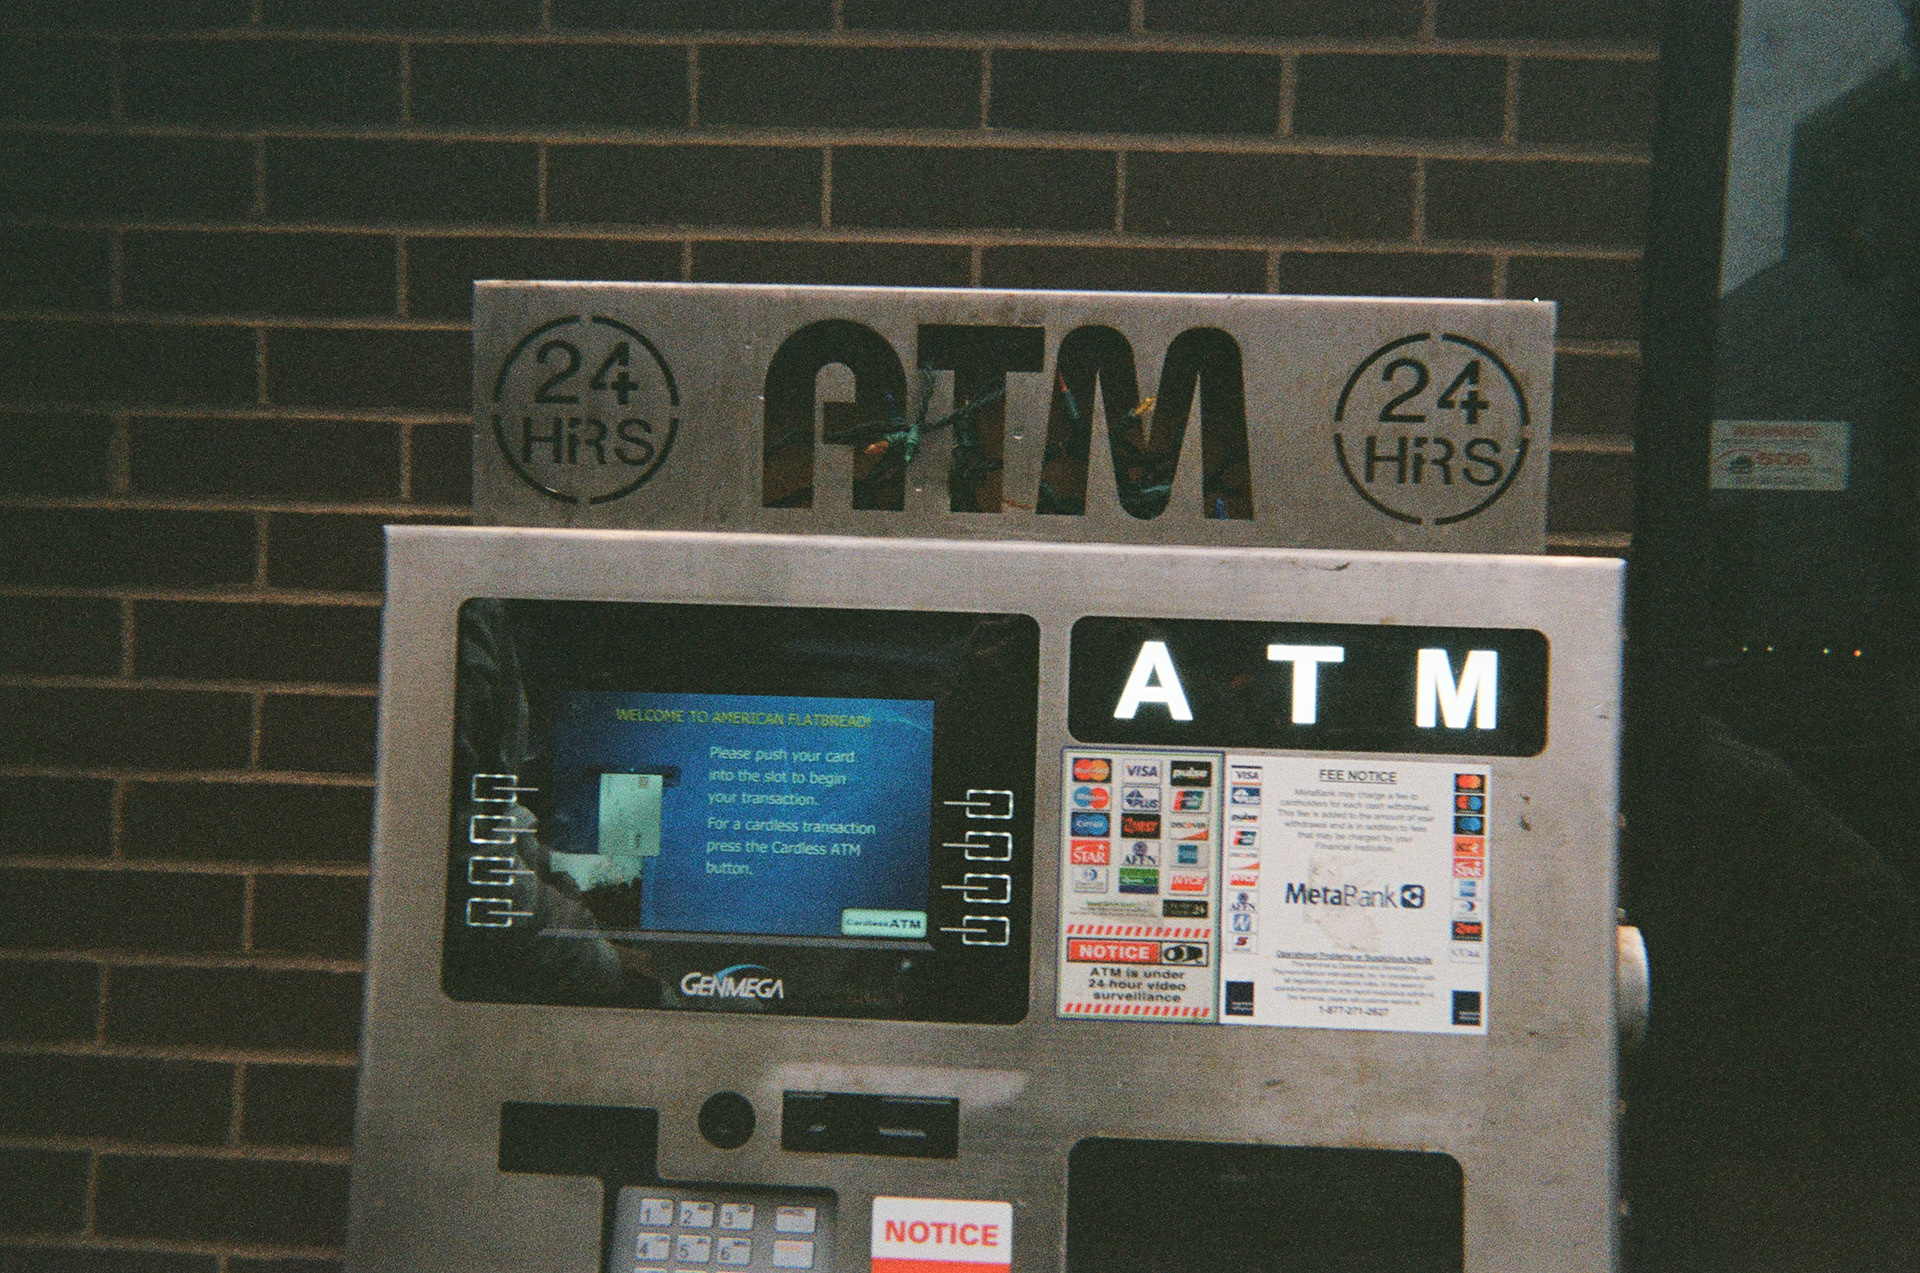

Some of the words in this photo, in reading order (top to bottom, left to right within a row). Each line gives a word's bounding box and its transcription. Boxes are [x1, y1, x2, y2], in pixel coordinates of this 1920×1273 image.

[533, 340, 640, 405] 24
[1378, 357, 1490, 424] 24
[762, 318, 1254, 520] ATM
[616, 708, 685, 723] WELCOME
[688, 710, 708, 723] TO
[712, 711, 784, 726] AMERICAN
[788, 713, 872, 728] FLATBREAD!
[710, 746, 751, 761] Please
[755, 748, 787, 763] push
[792, 750, 822, 763] your
[825, 750, 855, 763] card
[708, 769, 734, 782] into
[738, 769, 759, 782] the
[764, 770, 788, 783] slot
[792, 771, 806, 784] to
[809, 772, 847, 787] begin
[1126, 765, 1157, 777] VISA
[1319, 769, 1345, 781] FEE
[1348, 770, 1397, 783] NOTICE
[707, 793, 737, 805] your
[742, 792, 818, 806] transaction.
[707, 817, 729, 830] For
[733, 821, 741, 830] a
[745, 819, 799, 833] cardless
[802, 822, 876, 834] transaction
[706, 841, 742, 854] press
[745, 840, 768, 853] the
[771, 841, 827, 855] Cardless
[831, 843, 861, 857] ATM
[1073, 850, 1106, 864] STAR
[706, 861, 753, 875] button.
[1285, 882, 1398, 908] MetaBank
[1078, 944, 1150, 959] NOTICE
[1089, 967, 1121, 977] ATM
[1126, 967, 1139, 978] is
[1144, 968, 1185, 979] under
[681, 971, 784, 999] GENMEGA
[1088, 978, 1104, 988] 24
[1109, 979, 1142, 990] hour
[1147, 979, 1186, 991] video
[1093, 991, 1182, 1003] surveillance
[644, 1208, 652, 1222] 1
[683, 1210, 694, 1224] 2
[724, 1212, 734, 1226] 3
[885, 1220, 999, 1247] NOTICE
[639, 1242, 649, 1256] 4
[679, 1243, 690, 1258] 5
[720, 1246, 731, 1261] 6
